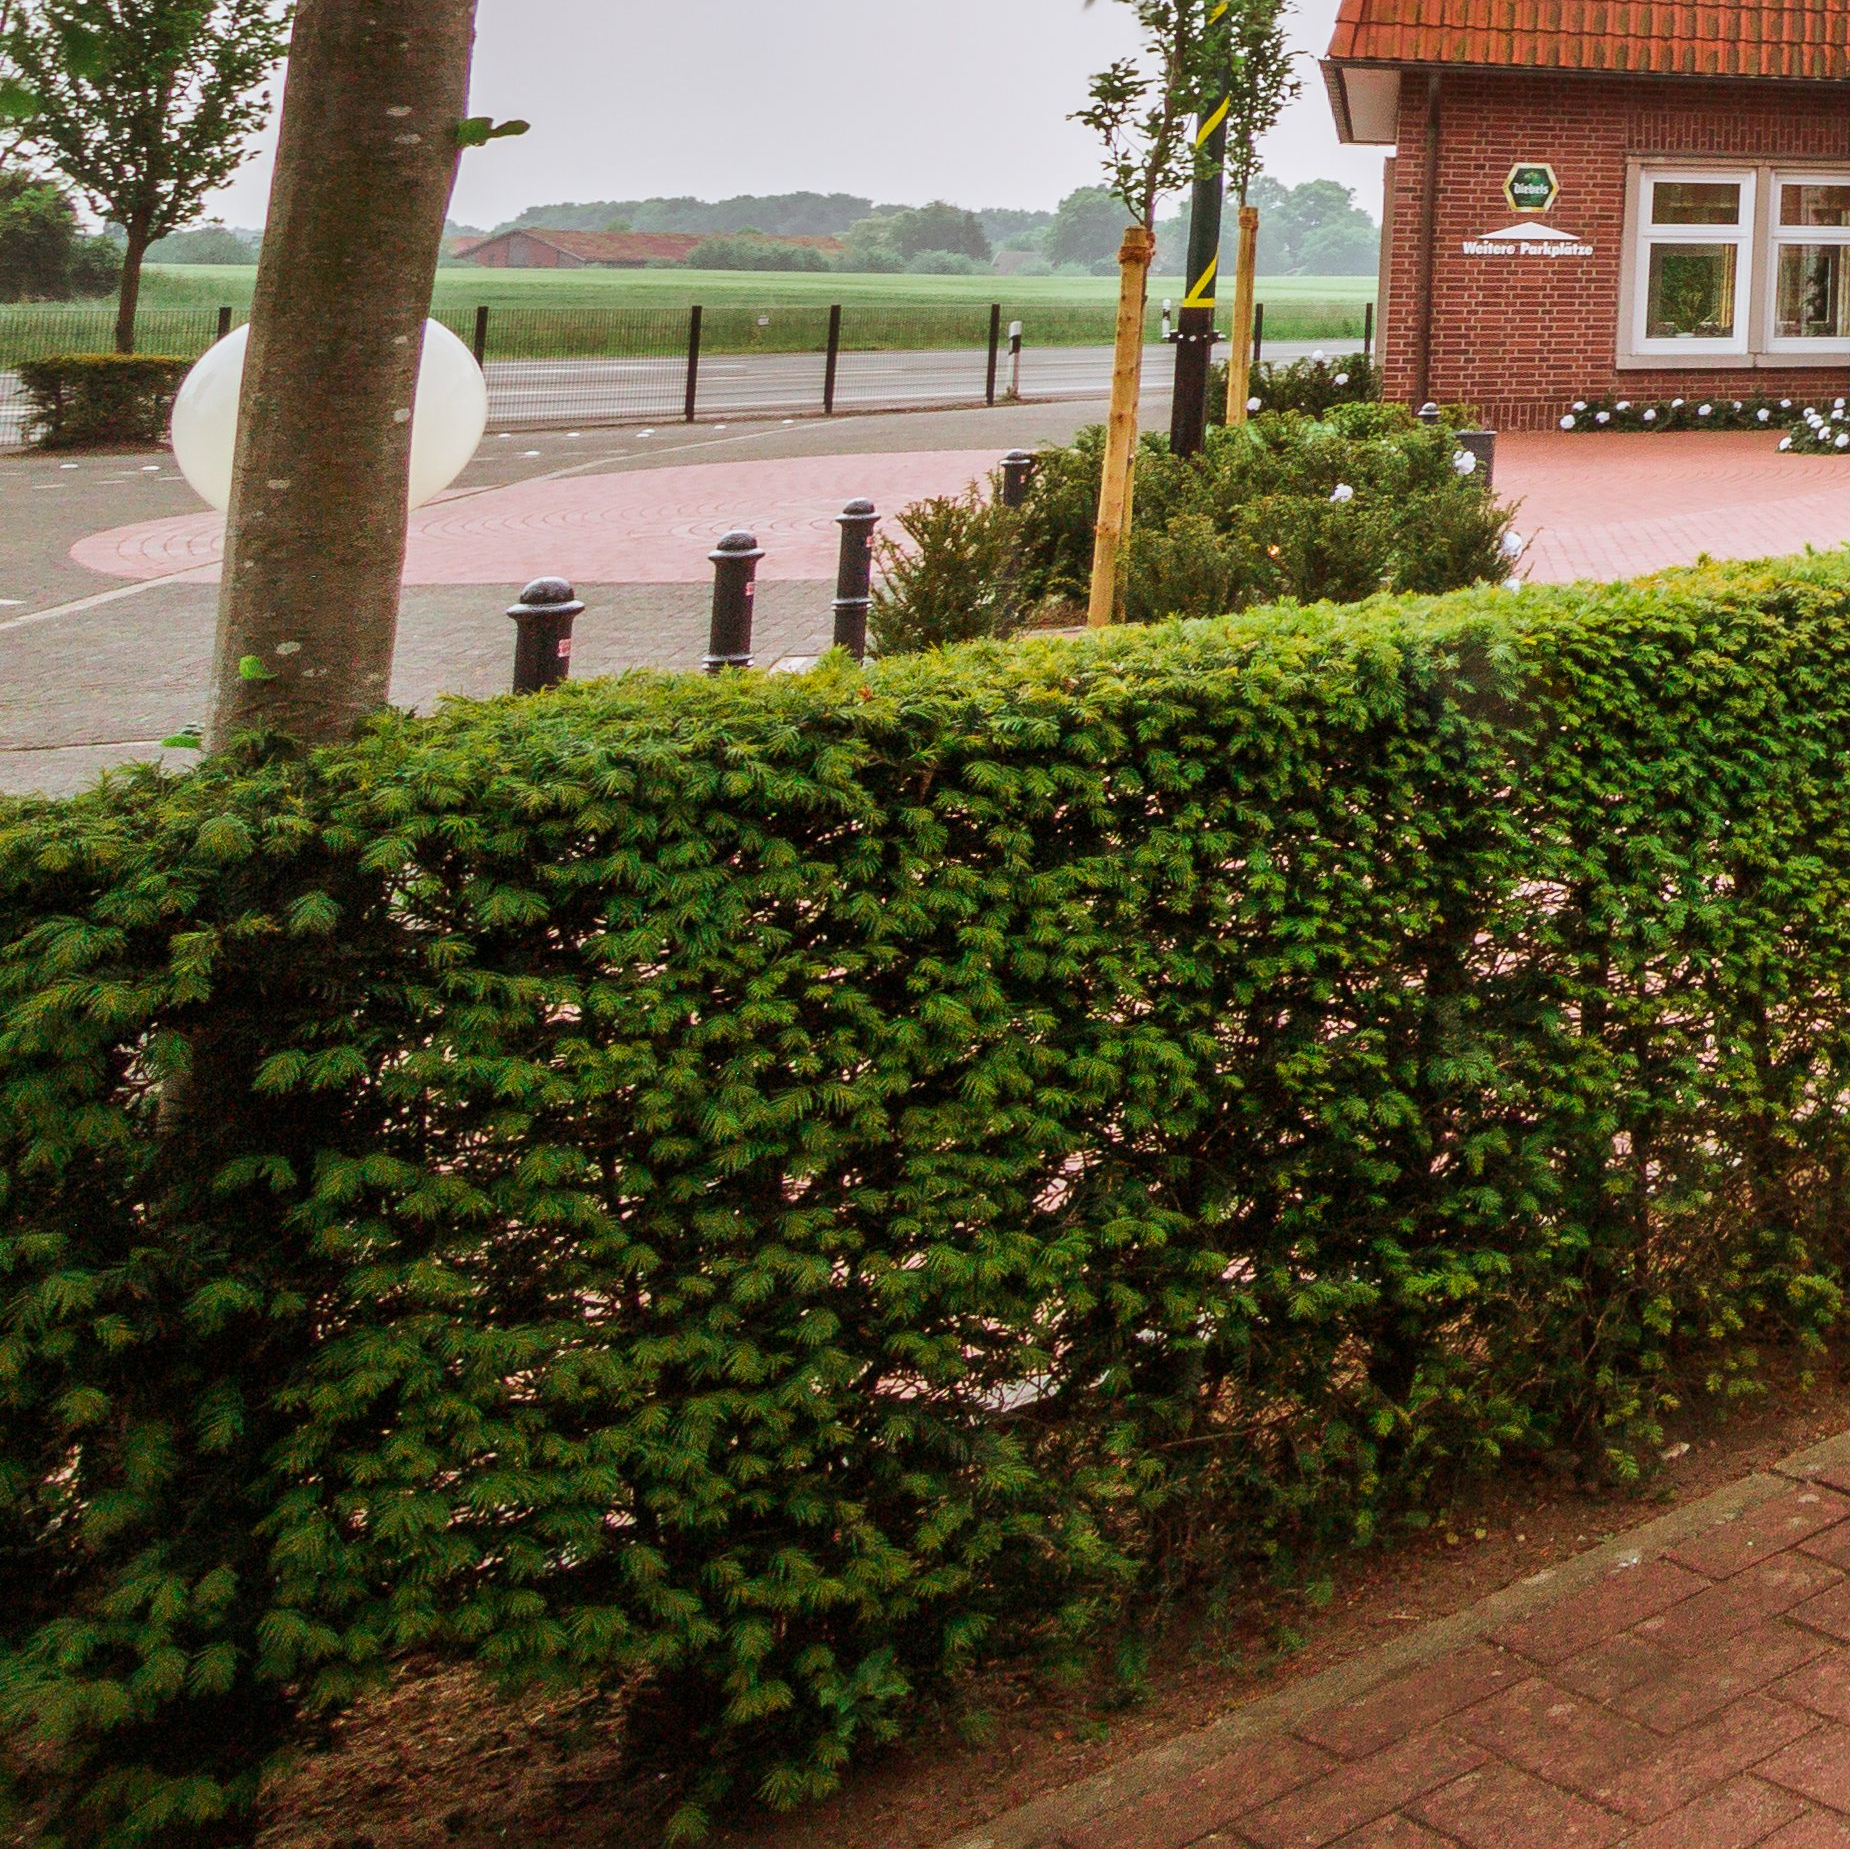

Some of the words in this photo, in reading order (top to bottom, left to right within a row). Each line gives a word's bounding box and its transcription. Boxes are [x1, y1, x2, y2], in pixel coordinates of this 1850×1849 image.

[1512, 183, 1549, 194] Diebels
[1462, 241, 1515, 255] Weitere
[1520, 242, 1593, 257] Parkplätze
